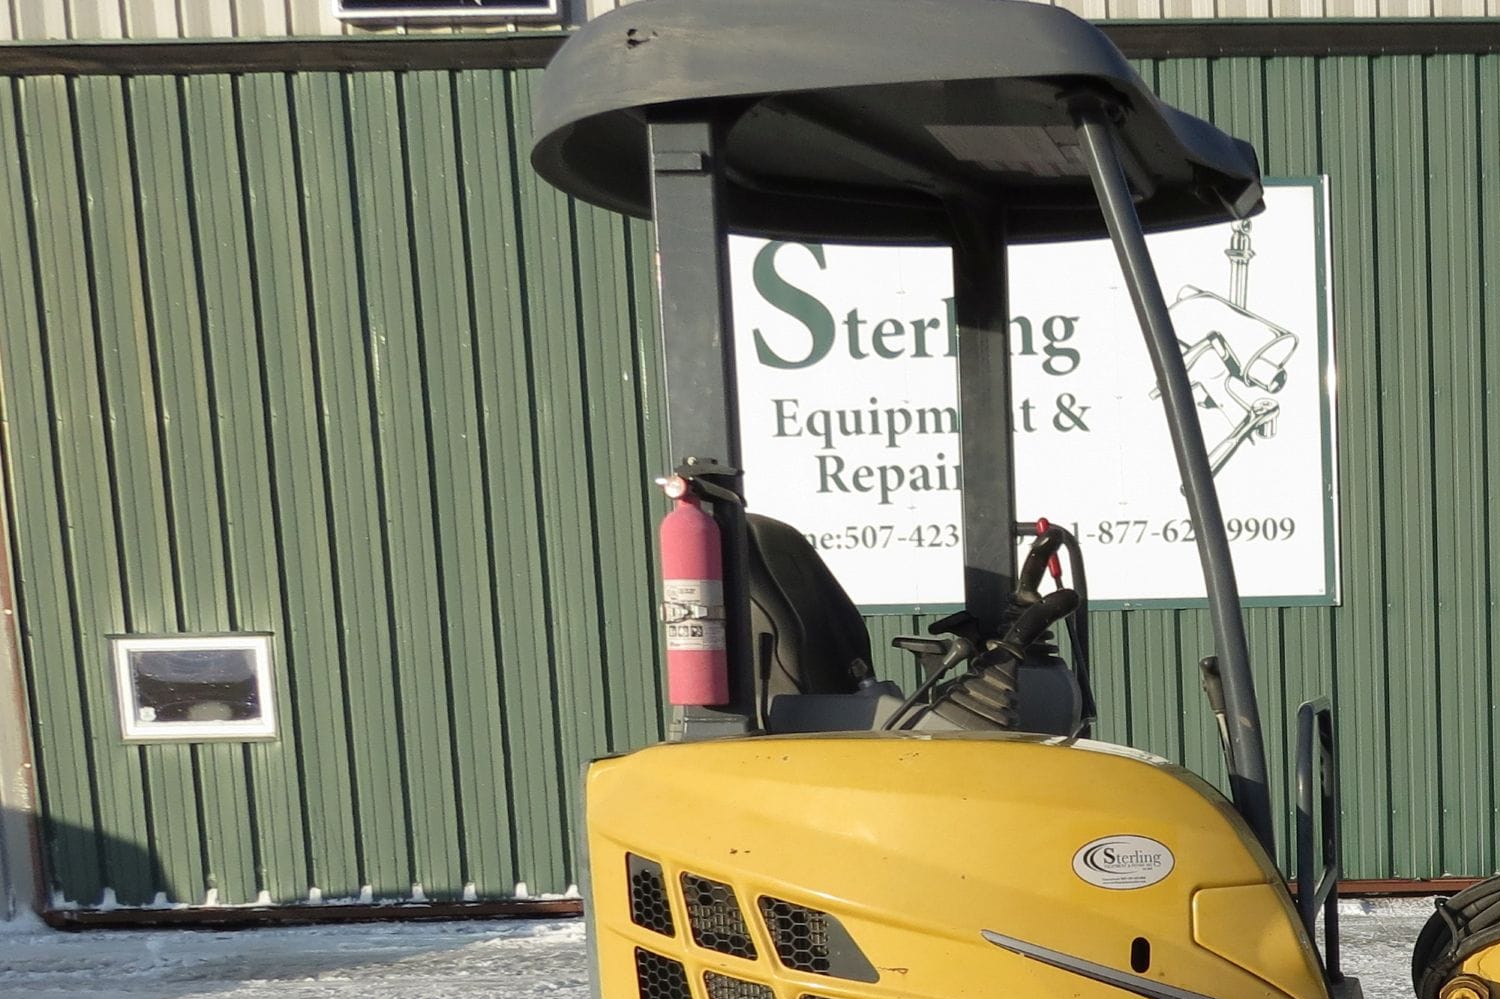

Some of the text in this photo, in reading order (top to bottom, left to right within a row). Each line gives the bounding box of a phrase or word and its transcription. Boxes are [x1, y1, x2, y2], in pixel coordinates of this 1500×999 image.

[752, 241, 1080, 376] Sterlng
[770, 392, 1092, 449] Equipmt &
[1103, 847, 1162, 867] Sterling
